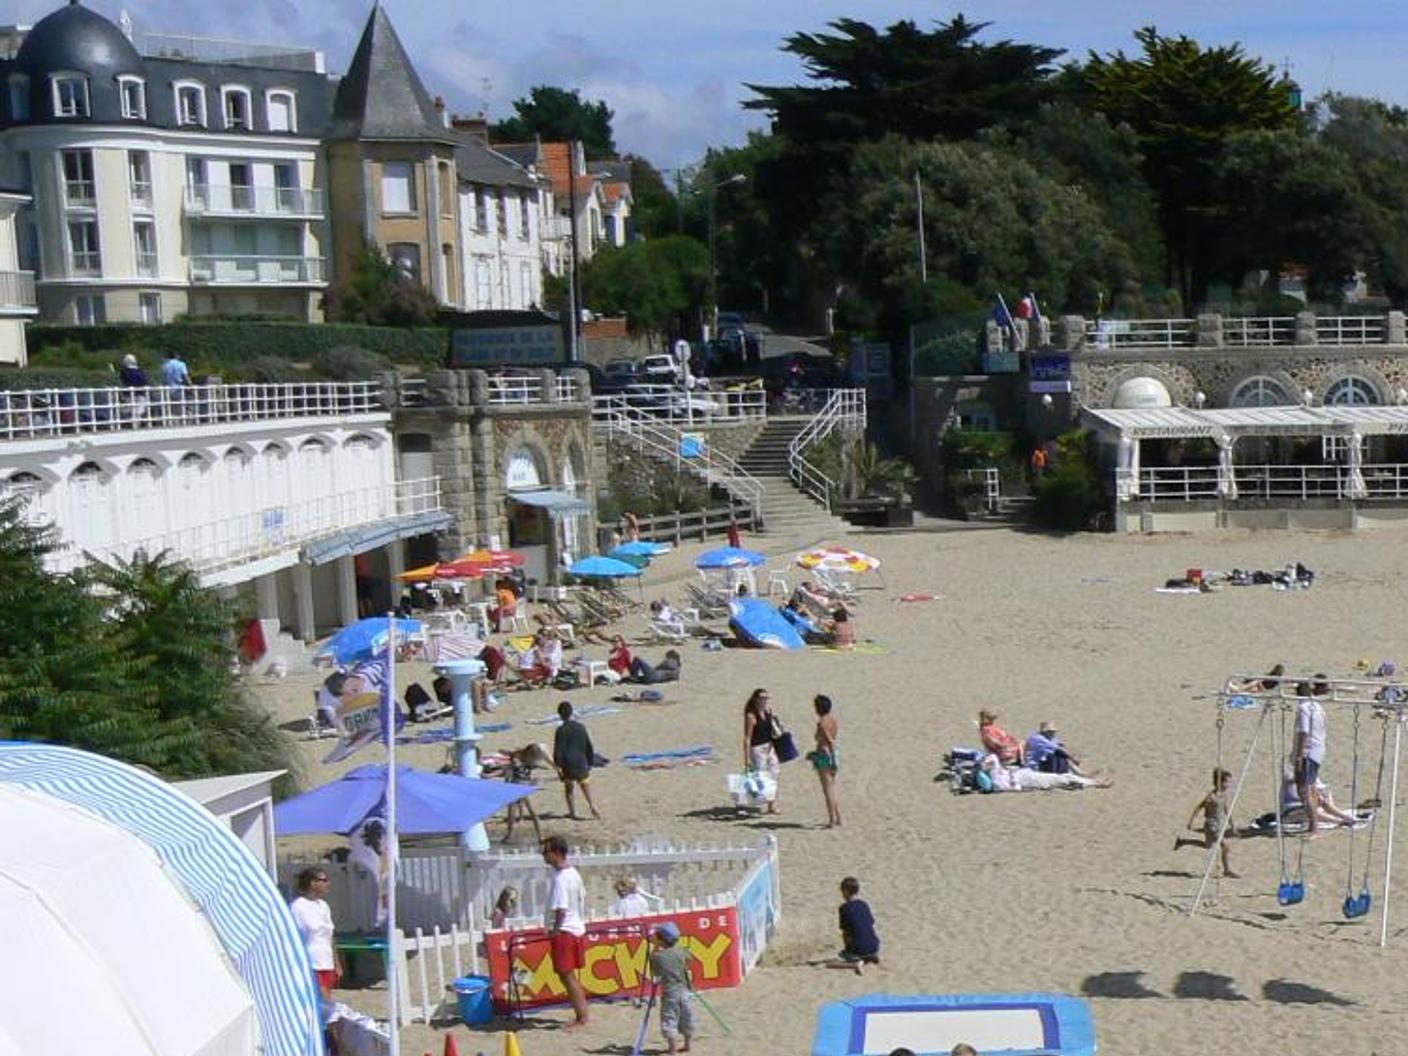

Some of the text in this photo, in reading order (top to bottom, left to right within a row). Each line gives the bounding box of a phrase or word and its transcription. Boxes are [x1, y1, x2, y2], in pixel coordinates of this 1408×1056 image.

[1132, 426, 1213, 436] RESTAURANT
[698, 915, 728, 930] DE
[511, 932, 732, 996] MCKY
